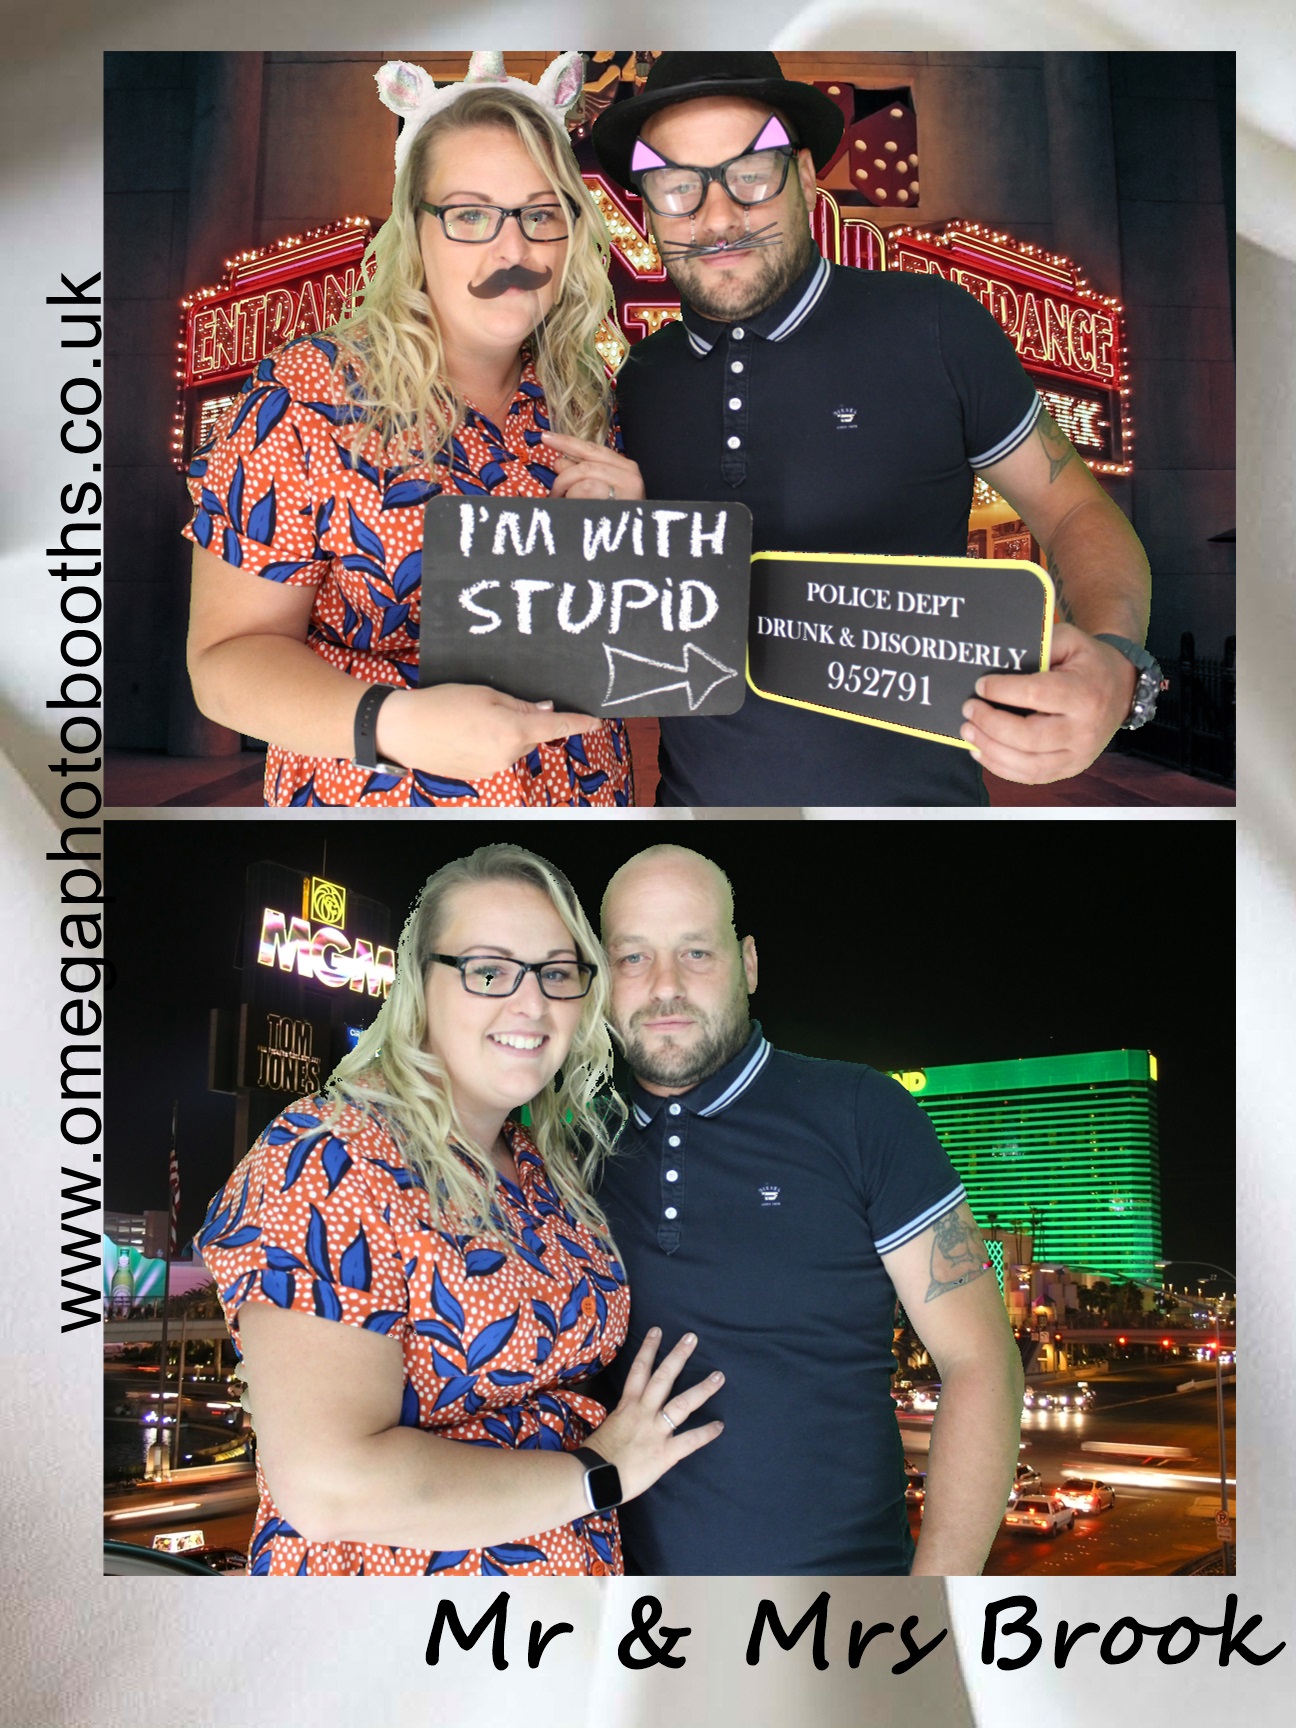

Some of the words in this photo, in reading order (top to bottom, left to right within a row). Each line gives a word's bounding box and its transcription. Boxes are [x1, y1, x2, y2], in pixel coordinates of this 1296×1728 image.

[459, 503, 556, 558] I'M
[806, 582, 891, 611] POLICE
[897, 591, 966, 618] DEPT
[757, 615, 836, 646] DRUNK
[838, 627, 857, 648] &
[861, 629, 1028, 671] DISORDERLY
[827, 661, 932, 706] 952791
[257, 907, 396, 999] MGM
[267, 1013, 313, 1057] TOM
[257, 1051, 320, 1095] JONES
